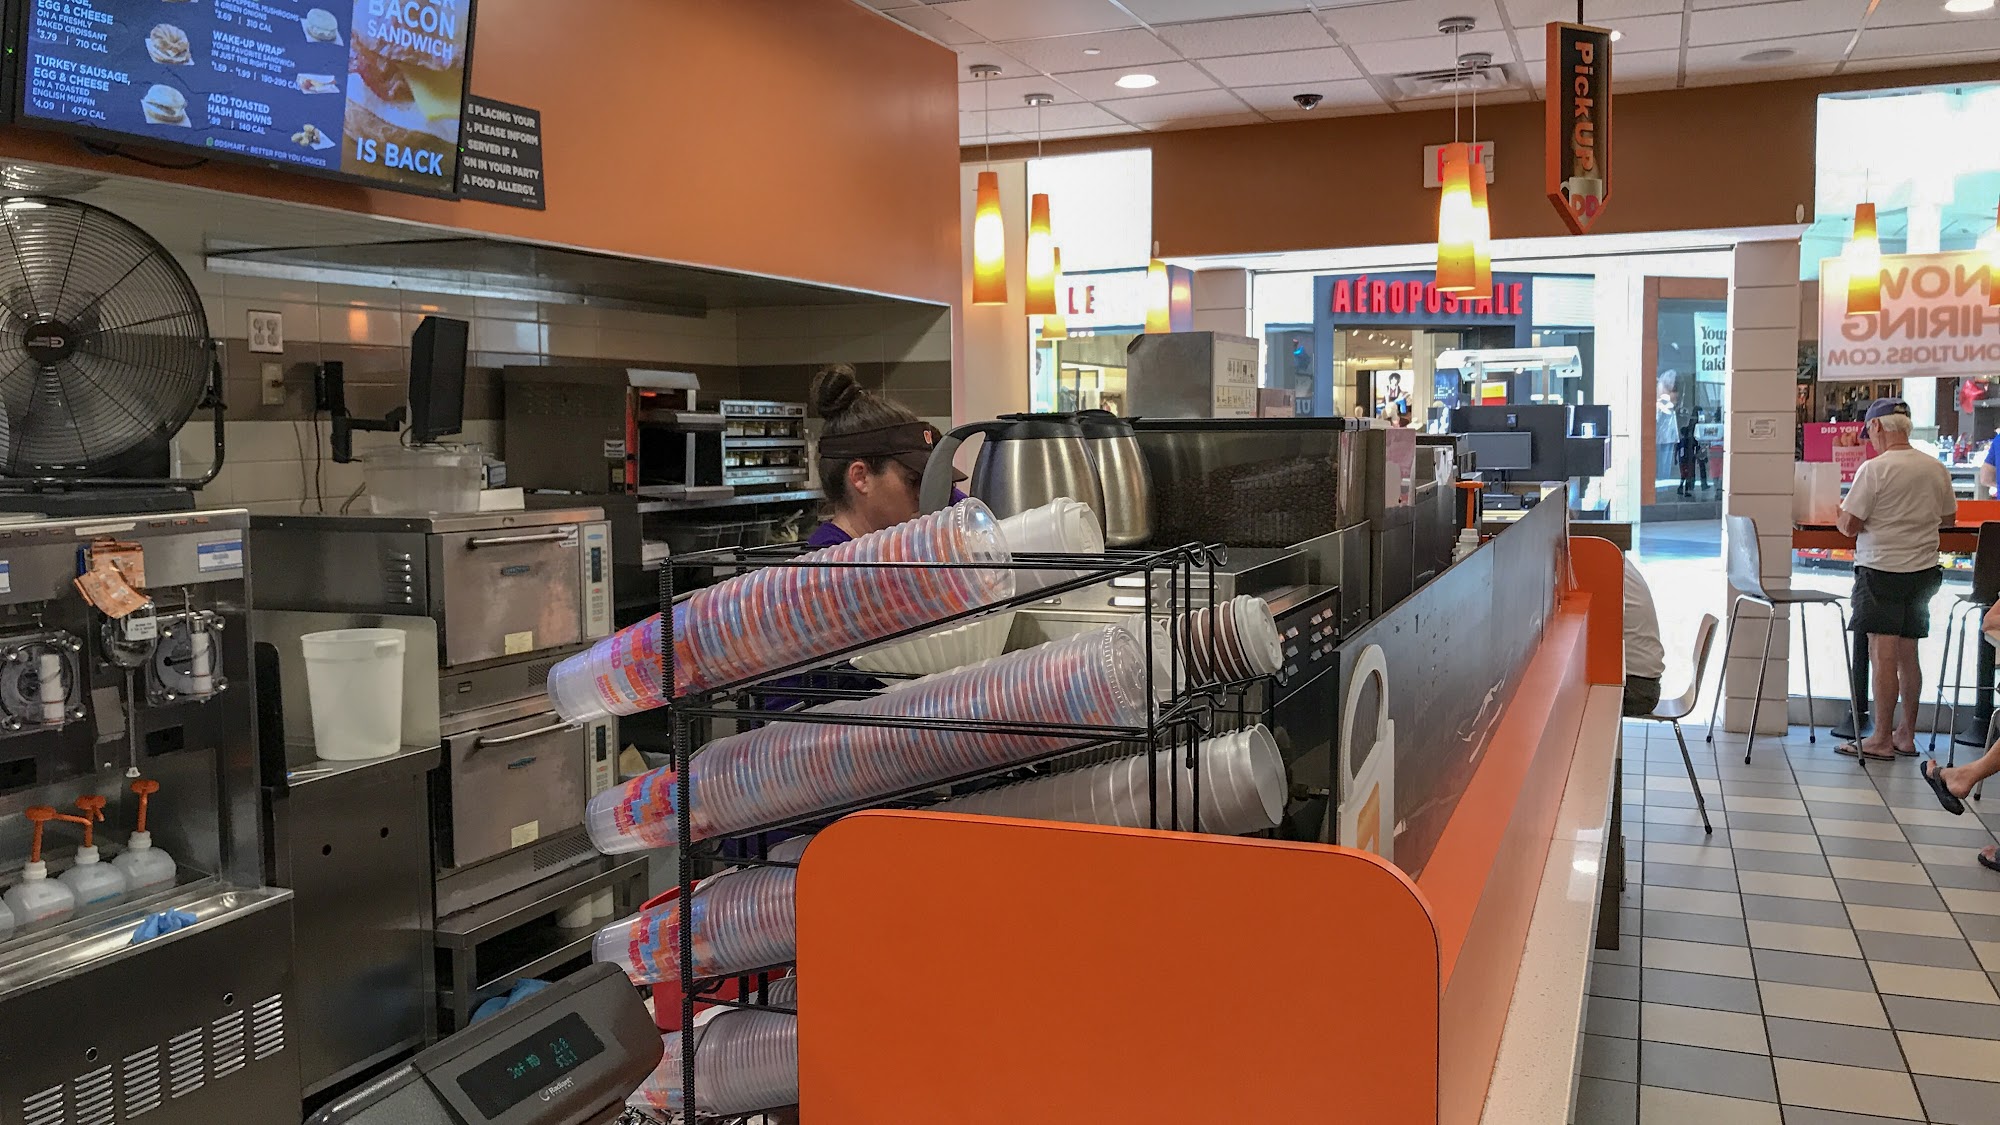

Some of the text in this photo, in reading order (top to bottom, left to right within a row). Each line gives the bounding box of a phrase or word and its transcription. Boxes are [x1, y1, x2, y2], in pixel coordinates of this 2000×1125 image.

[37, 0, 114, 25] EGG & CHEESE
[37, 9, 93, 29] ON A FRESHLY
[368, 0, 455, 40] BACON
[36, 18, 108, 42] BAKED CROISSANT
[259, 23, 272, 33] CAL
[36, 28, 108, 53] $3.79 710 CAL
[212, 41, 231, 51] YOUR
[231, 46, 262, 60] FAVORITE
[213, 31, 255, 49] WAKE-UP
[367, 19, 453, 61] SANDWICH
[33, 67, 110, 92] EGG & CHEESE
[35, 54, 131, 86] TURKEY SAUSAGE,
[32, 87, 96, 107] ENGLISH MUFFIN
[33, 78, 90, 97] ON A TOASTED
[72, 106, 88, 117] 470
[89, 110, 106, 120] CAL
[208, 93, 270, 114] ADD TOASTED
[208, 104, 272, 126] HASH BROWNS
[475, 105, 511, 123] PLACING
[512, 113, 536, 128] YOUR
[252, 125, 266, 135] CAL
[474, 122, 507, 139] PLEASE
[507, 129, 539, 146] INFORM
[356, 137, 444, 176] IS BACK
[467, 139, 518, 159] SERVER IF A
[478, 159, 487, 170] IN
[488, 161, 512, 175] YOUR
[512, 165, 540, 180] PARTY
[462, 174, 536, 196] A FOOD ALLERGY.
[1701, 342, 1720, 355] for
[596, 675, 616, 706] DONUTS
[548, 1077, 572, 1095] Radiant
